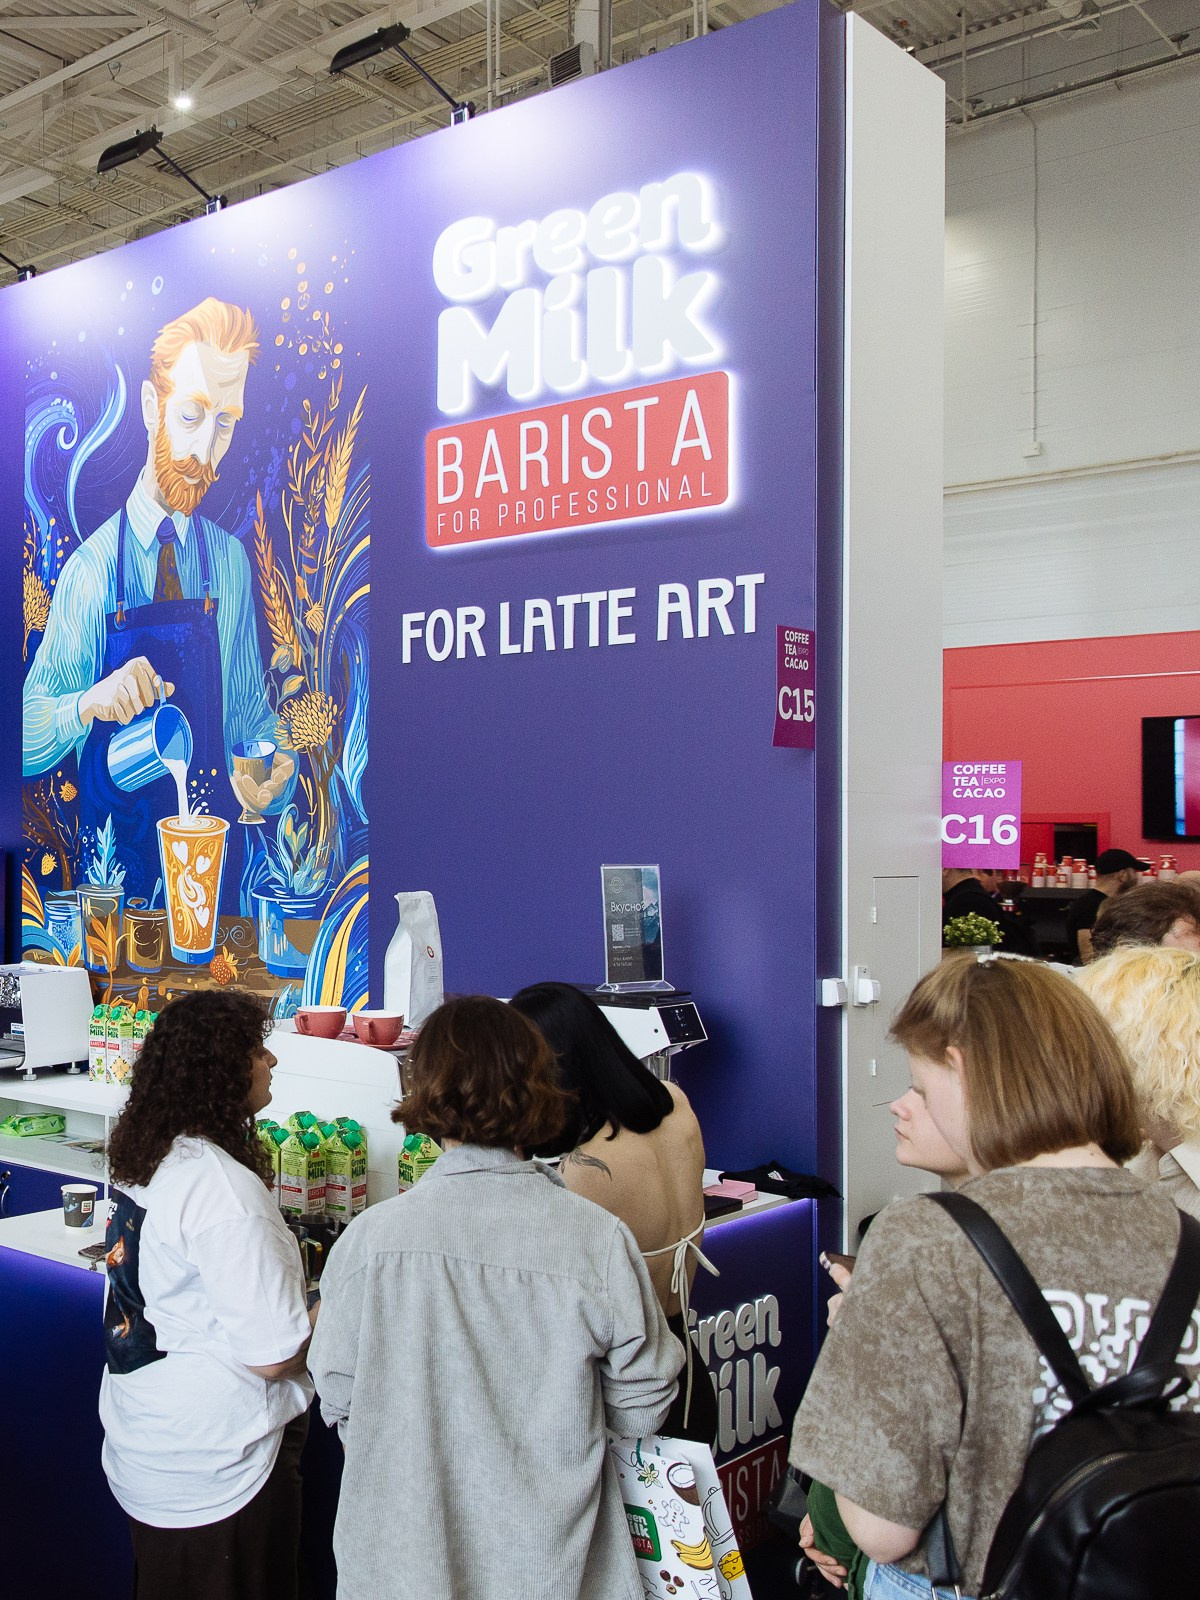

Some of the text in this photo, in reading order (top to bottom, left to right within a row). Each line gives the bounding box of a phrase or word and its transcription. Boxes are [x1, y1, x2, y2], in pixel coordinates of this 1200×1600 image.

[432, 172, 714, 301] Green
[437, 256, 717, 413] Milk
[437, 389, 713, 505] BARISTA
[438, 472, 712, 535] FOR PROFESSIONAL
[401, 573, 766, 664] FOR LATTE ART
[784, 630, 809, 645] COFFEE
[784, 643, 797, 656] TEA
[784, 657, 809, 671] CACAO
[778, 685, 815, 723] C15
[953, 764, 1006, 775] COFFEE
[953, 776, 1006, 787] TEA EXPO
[952, 788, 1006, 798] CACAO
[941, 814, 1018, 845] C16
[709, 1352, 783, 1457] ilk
[720, 1450, 781, 1520] ISTA
